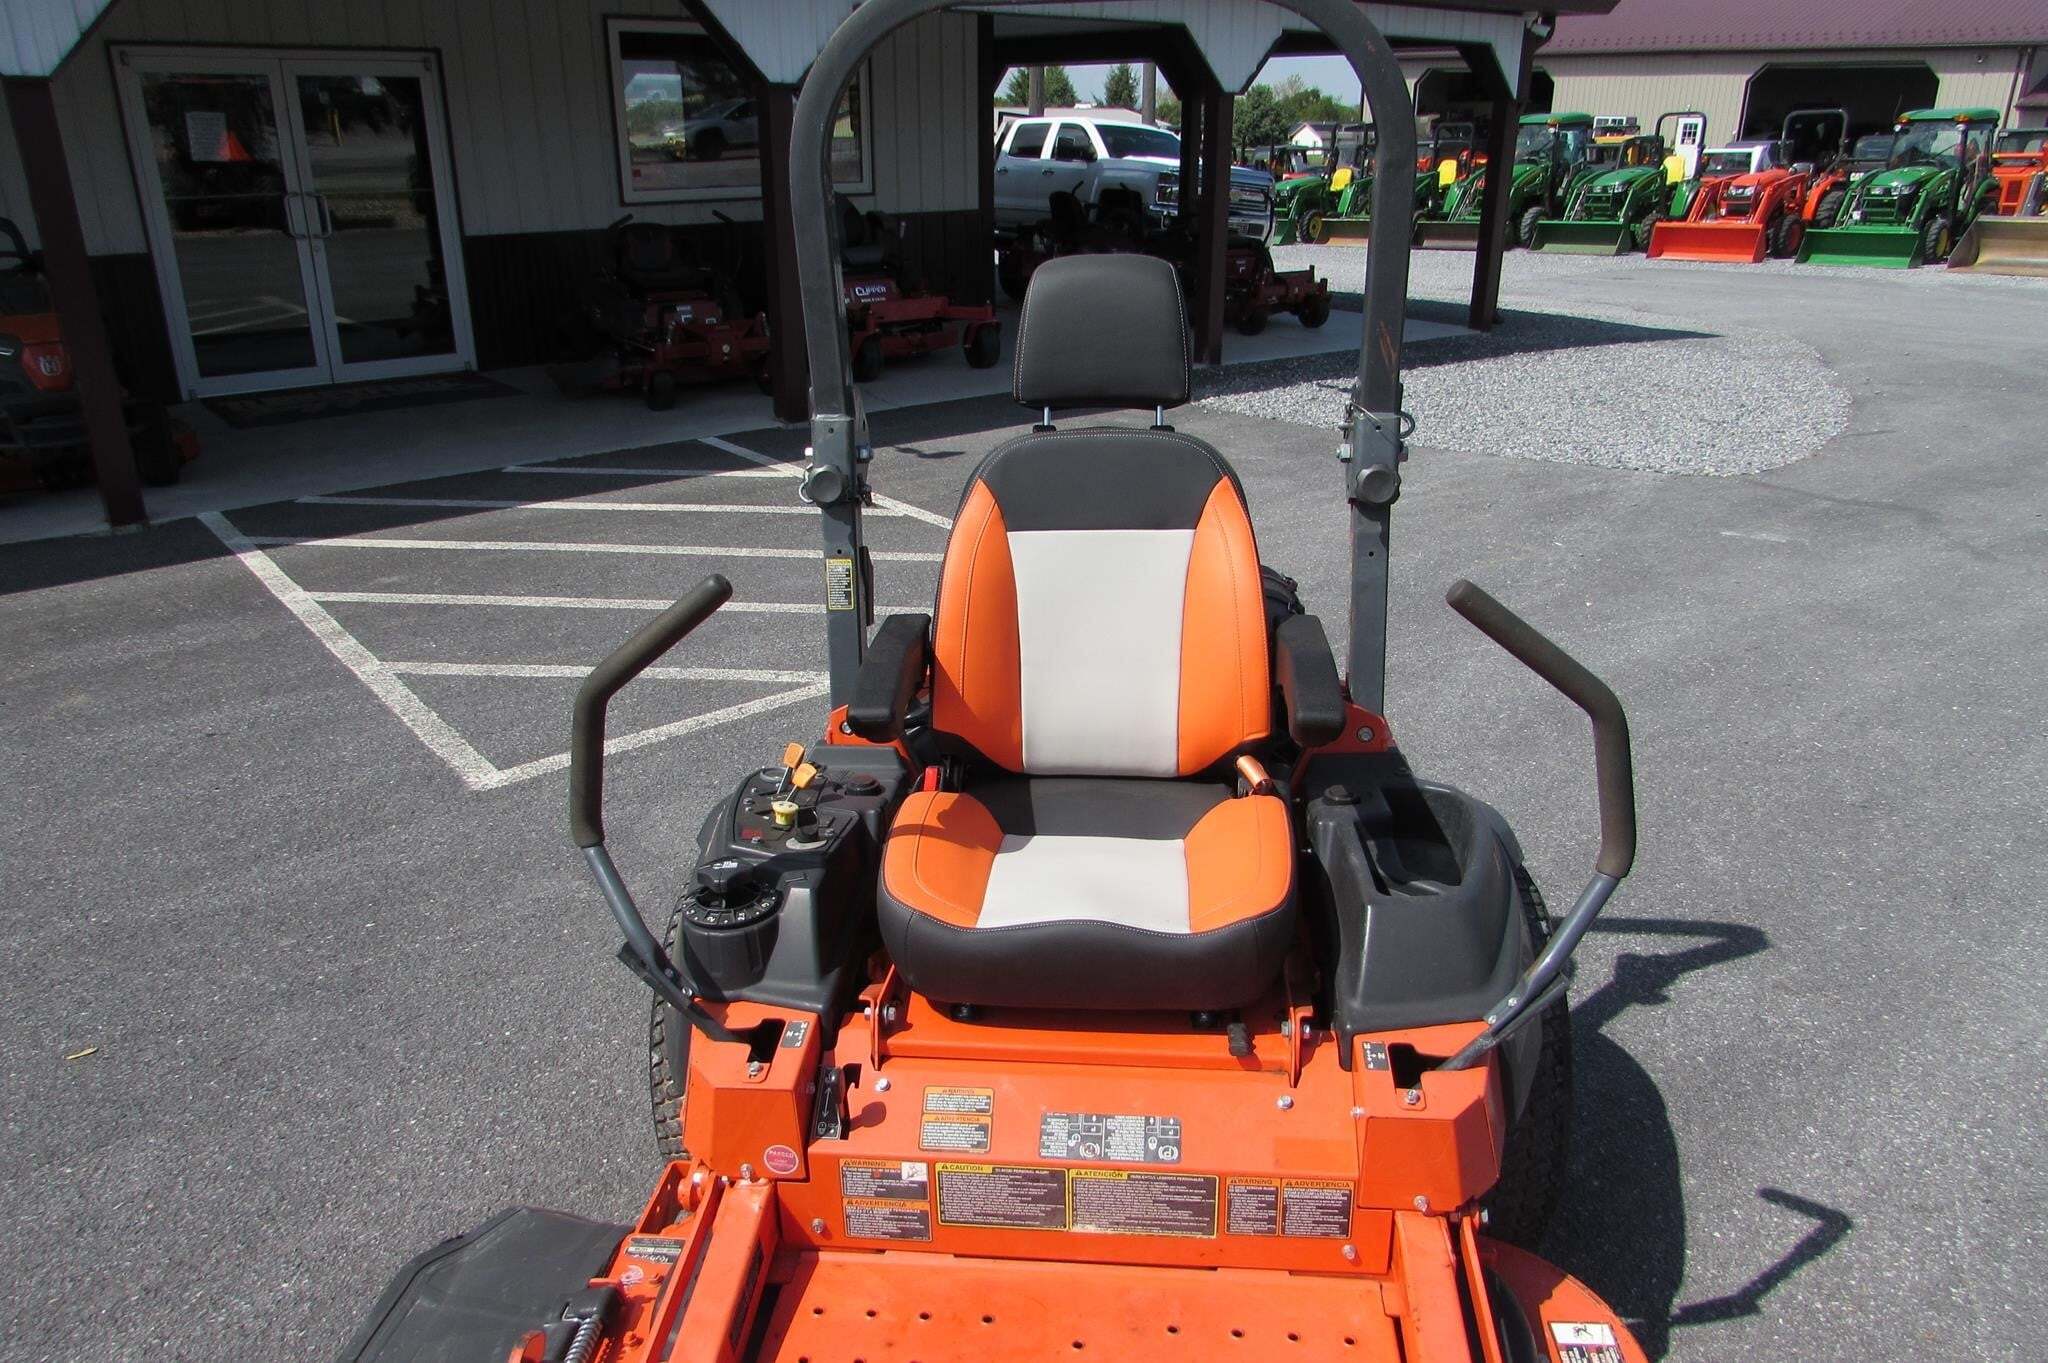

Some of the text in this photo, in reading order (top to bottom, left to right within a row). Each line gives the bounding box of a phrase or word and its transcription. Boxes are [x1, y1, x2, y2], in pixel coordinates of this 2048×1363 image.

[855, 286, 887, 296] CLIPPER
[949, 1164, 984, 1172] CAUTION
[1084, 1170, 1123, 1178] ATENCIÓN
[1294, 1180, 1350, 1188] ADVERTENCIA
[855, 1199, 907, 1208] ADVERTENCIA
